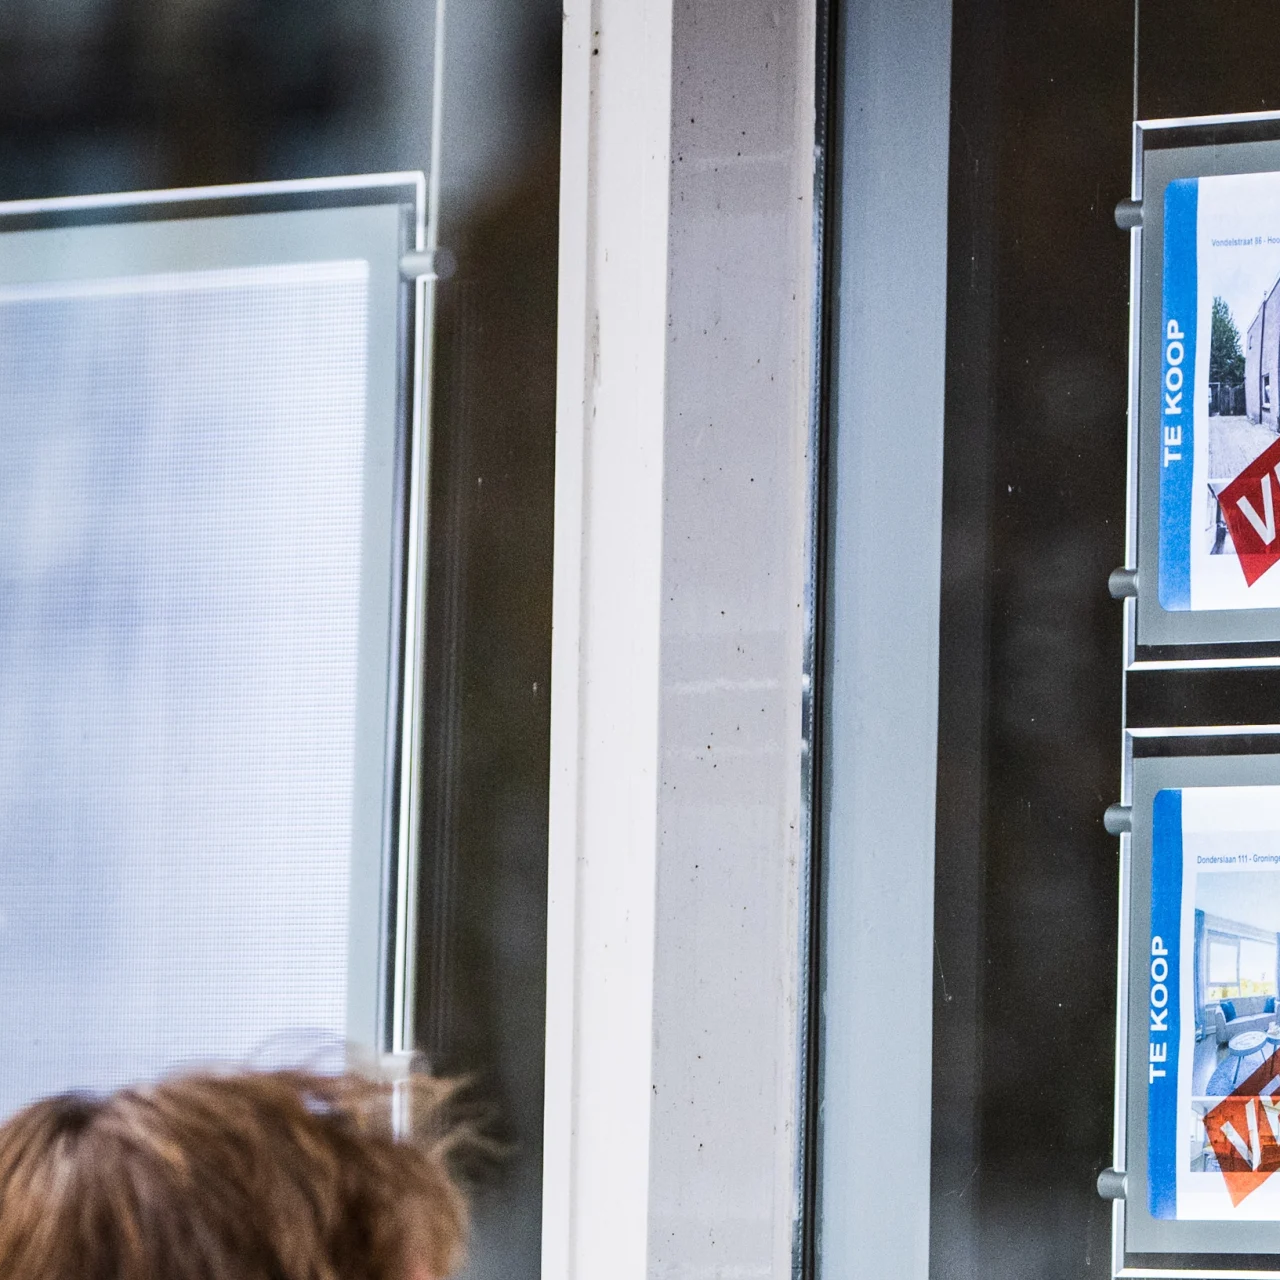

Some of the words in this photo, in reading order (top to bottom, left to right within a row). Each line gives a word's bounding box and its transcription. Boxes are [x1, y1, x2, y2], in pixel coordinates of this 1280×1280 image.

[1211, 238, 1253, 247] Vondelstraat
[1165, 319, 1184, 415] KOOP
[1164, 426, 1182, 467] TE
[1197, 855, 1236, 864] Donderslaan
[1238, 855, 1248, 863] 111
[1150, 934, 1168, 1033] KOOP
[1148, 1040, 1168, 1084] TE
